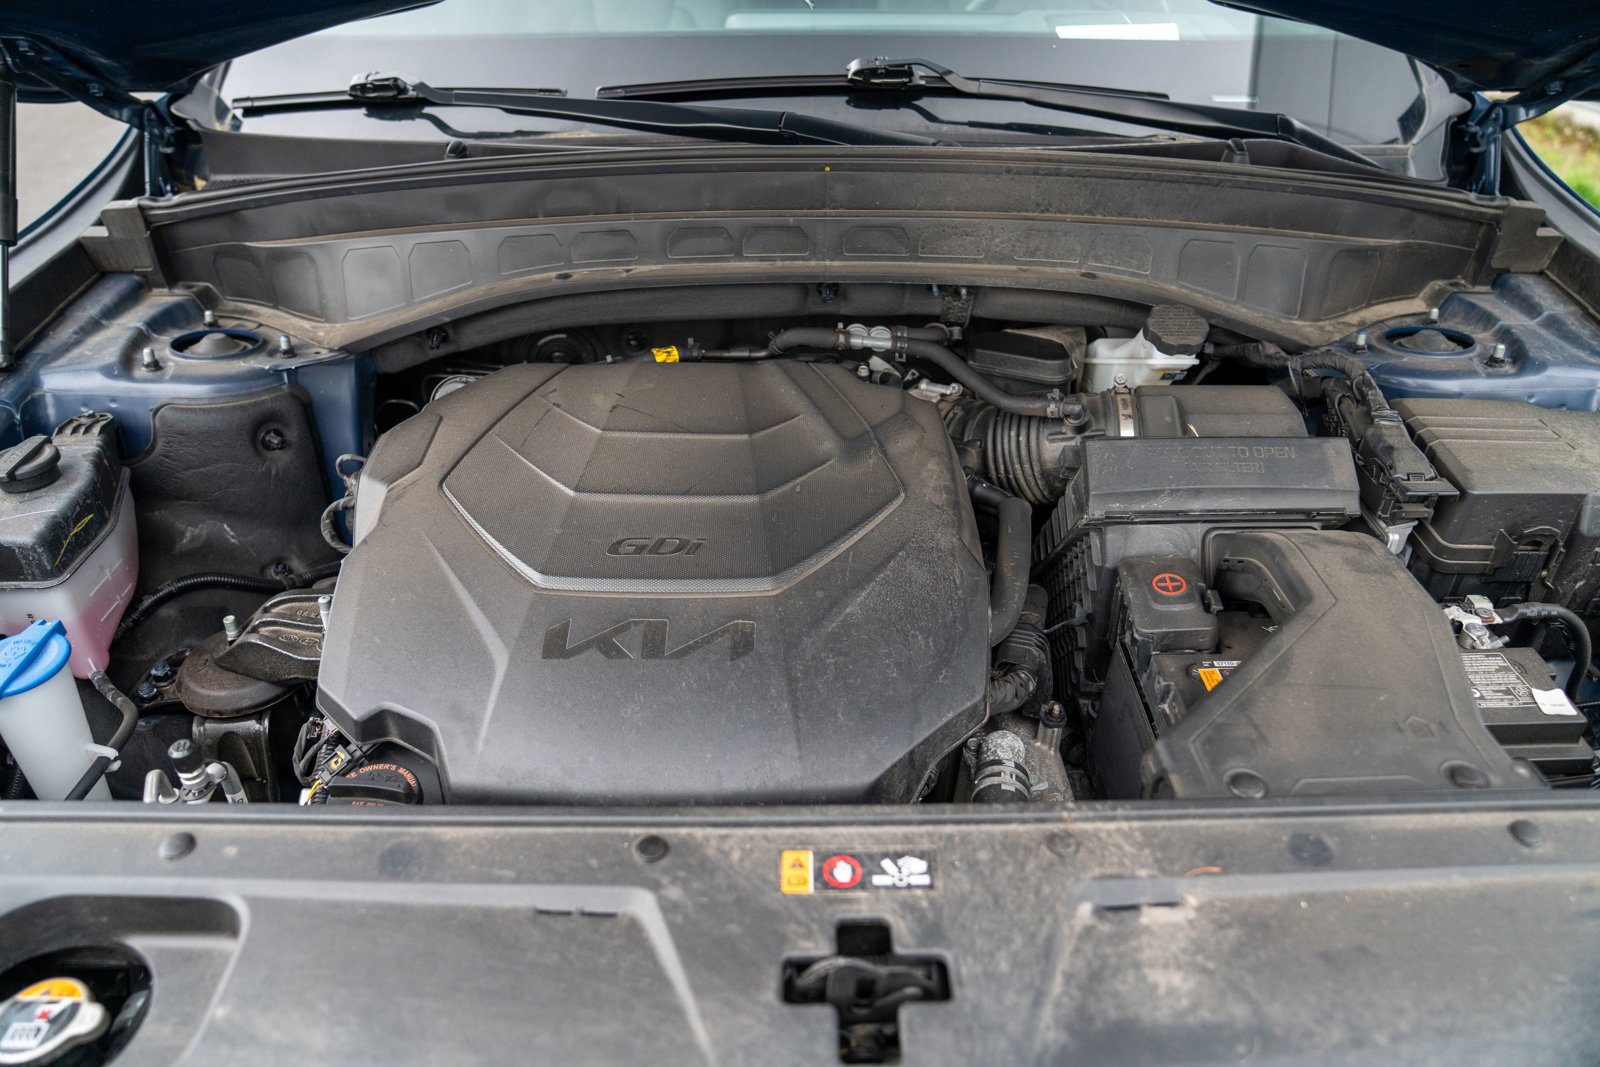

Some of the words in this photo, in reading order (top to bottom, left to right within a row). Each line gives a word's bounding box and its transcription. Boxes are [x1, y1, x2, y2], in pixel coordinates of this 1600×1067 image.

[1227, 446, 1250, 458] TO
[1252, 446, 1296, 459] OPEN
[606, 537, 706, 556] GDi
[359, 763, 397, 774] OWNER'S
[398, 767, 417, 787] MANUAL
